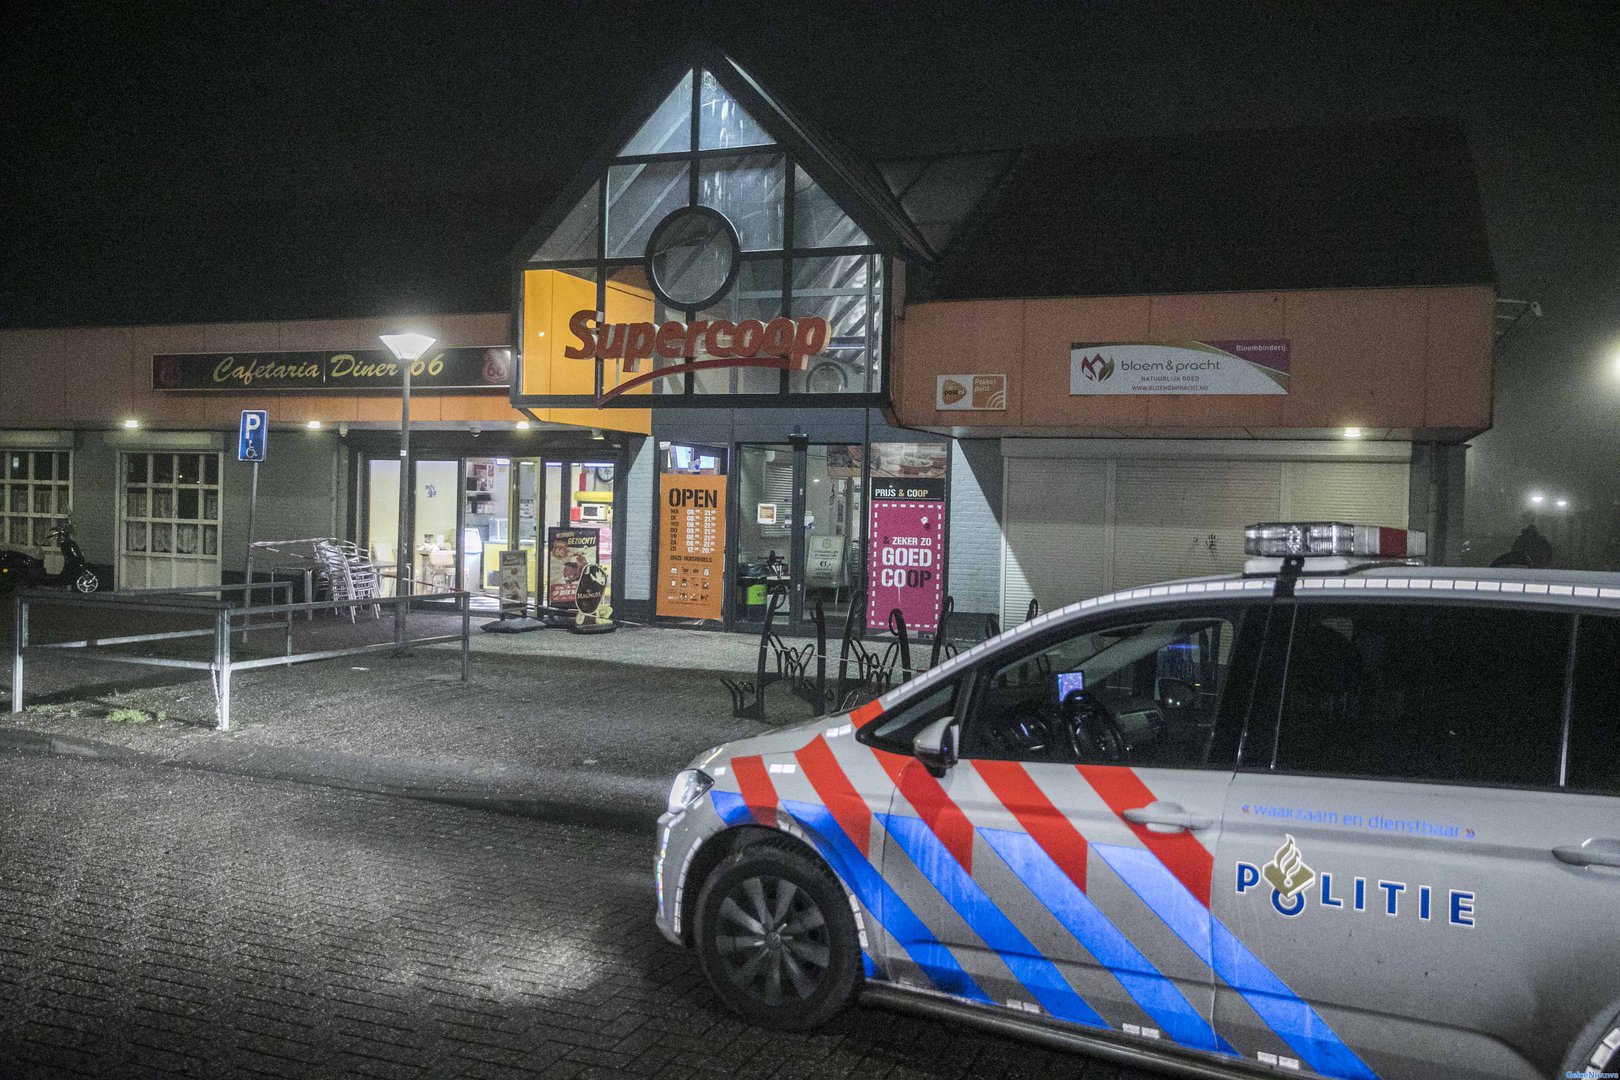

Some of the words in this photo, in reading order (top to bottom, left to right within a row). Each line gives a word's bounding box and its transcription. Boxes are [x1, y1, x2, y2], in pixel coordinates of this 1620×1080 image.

[565, 310, 831, 373] Supercoop
[1236, 344, 1287, 352] Bloembinderij
[213, 356, 320, 385] Cafetaria
[331, 354, 399, 378] Diner
[409, 353, 446, 377] 66
[1121, 360, 1164, 371] bloem
[1165, 361, 1175, 370] &
[1175, 360, 1220, 373] pracht
[245, 414, 260, 439] P
[669, 488, 718, 508] OPEN
[875, 489, 896, 497] PRIJS
[906, 489, 928, 498] COOP
[892, 537, 918, 546] ZEKER
[920, 537, 932, 546] ZO
[882, 547, 932, 567] GOED
[881, 568, 932, 588] COOP
[1254, 803, 1338, 824] waakzaam
[1343, 814, 1363, 826] en
[1368, 815, 1461, 839] dienstbaar
[1235, 861, 1476, 928] POLITIE
